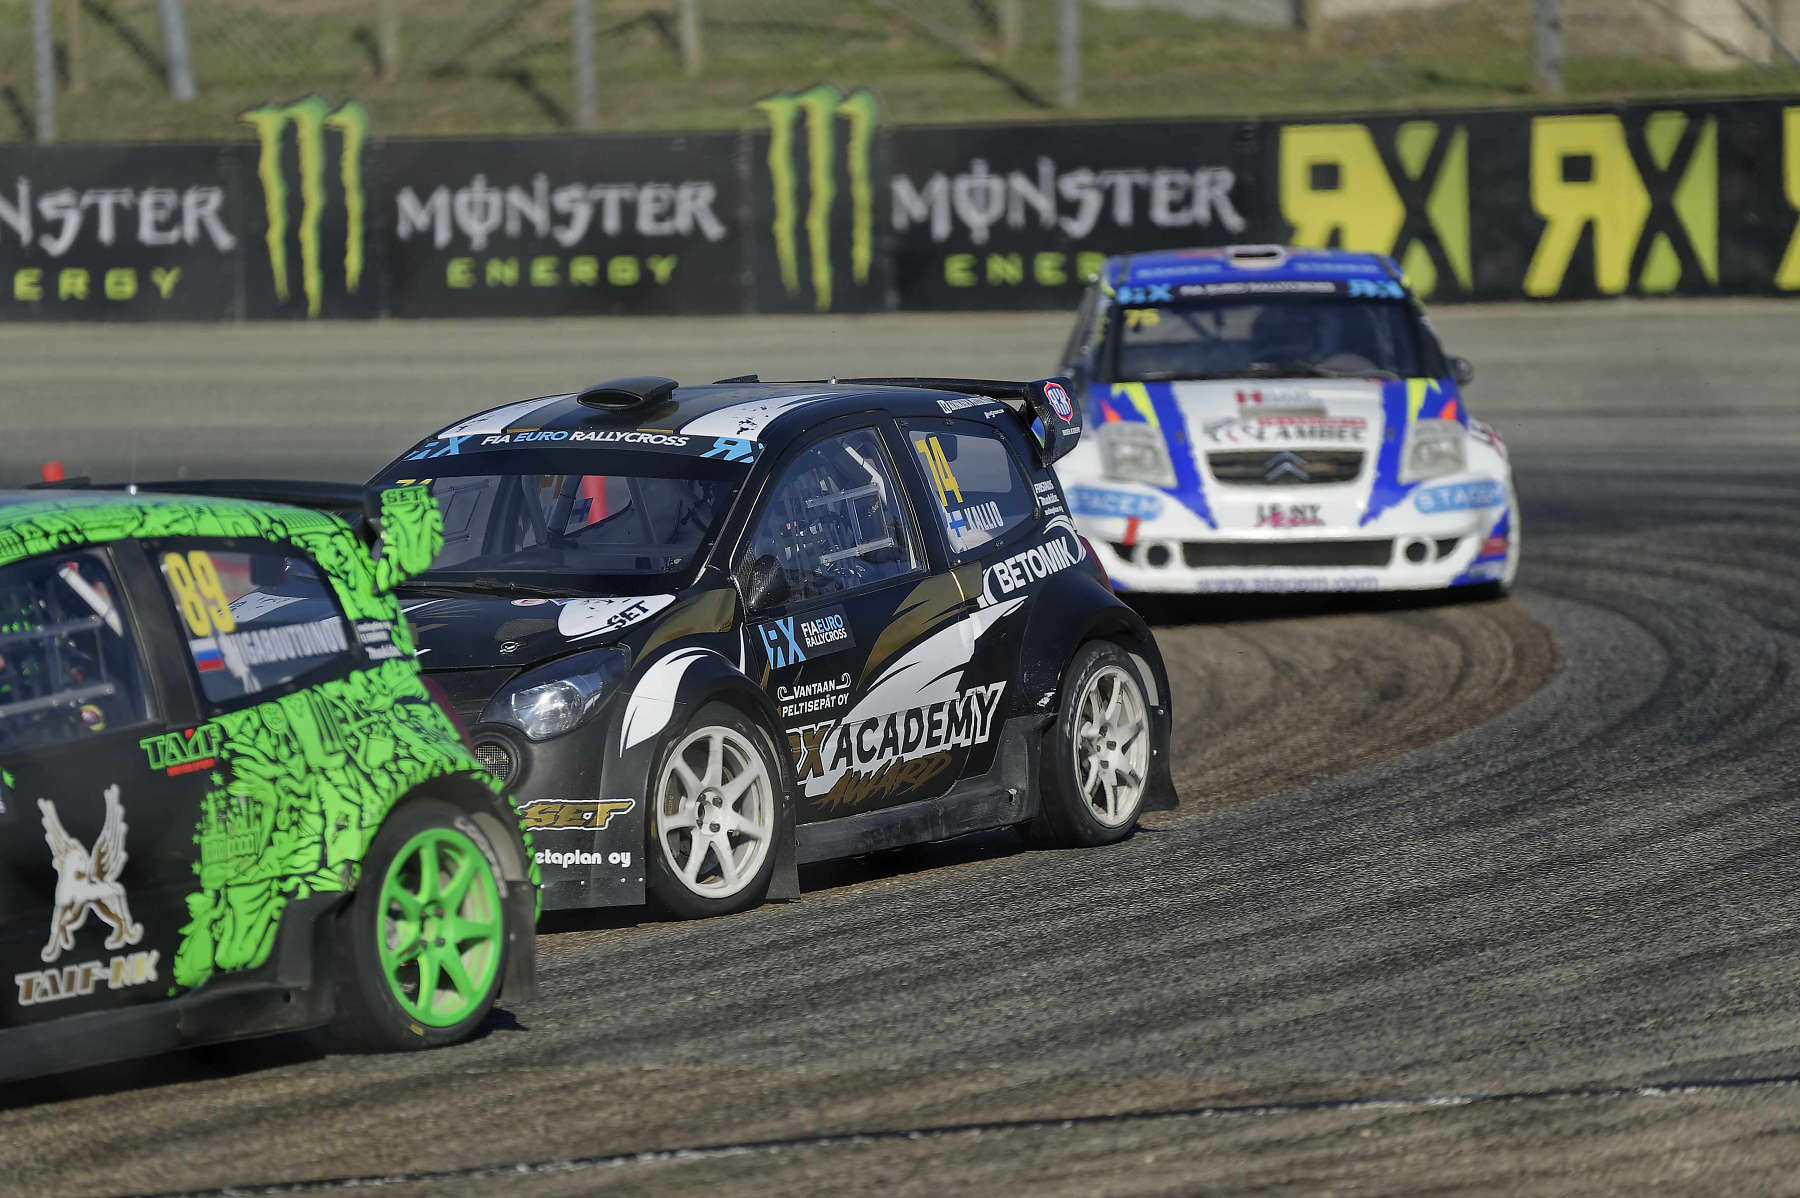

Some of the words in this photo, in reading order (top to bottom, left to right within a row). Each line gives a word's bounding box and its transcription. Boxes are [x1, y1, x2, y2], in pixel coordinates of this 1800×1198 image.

[397, 173, 726, 249] MONSTER
[891, 155, 1246, 244] MONSTER
[14, 266, 181, 301] ERGY
[446, 252, 679, 288] ENERGY
[481, 433, 510, 447] FIA
[514, 431, 569, 443] EURO
[569, 431, 690, 447] RALLYCROSS
[964, 501, 1004, 532] KALLIO
[993, 536, 1076, 594] BETOMIK
[164, 550, 236, 636] 89
[607, 600, 649, 629] SET
[805, 628, 847, 648] RALLYCROSS
[793, 680, 836, 699] VANTAAN
[838, 693, 849, 706] OY
[829, 683, 1003, 771] ACADEMY
[608, 851, 631, 868] oy
[15, 949, 160, 1006] TAIF-NK
